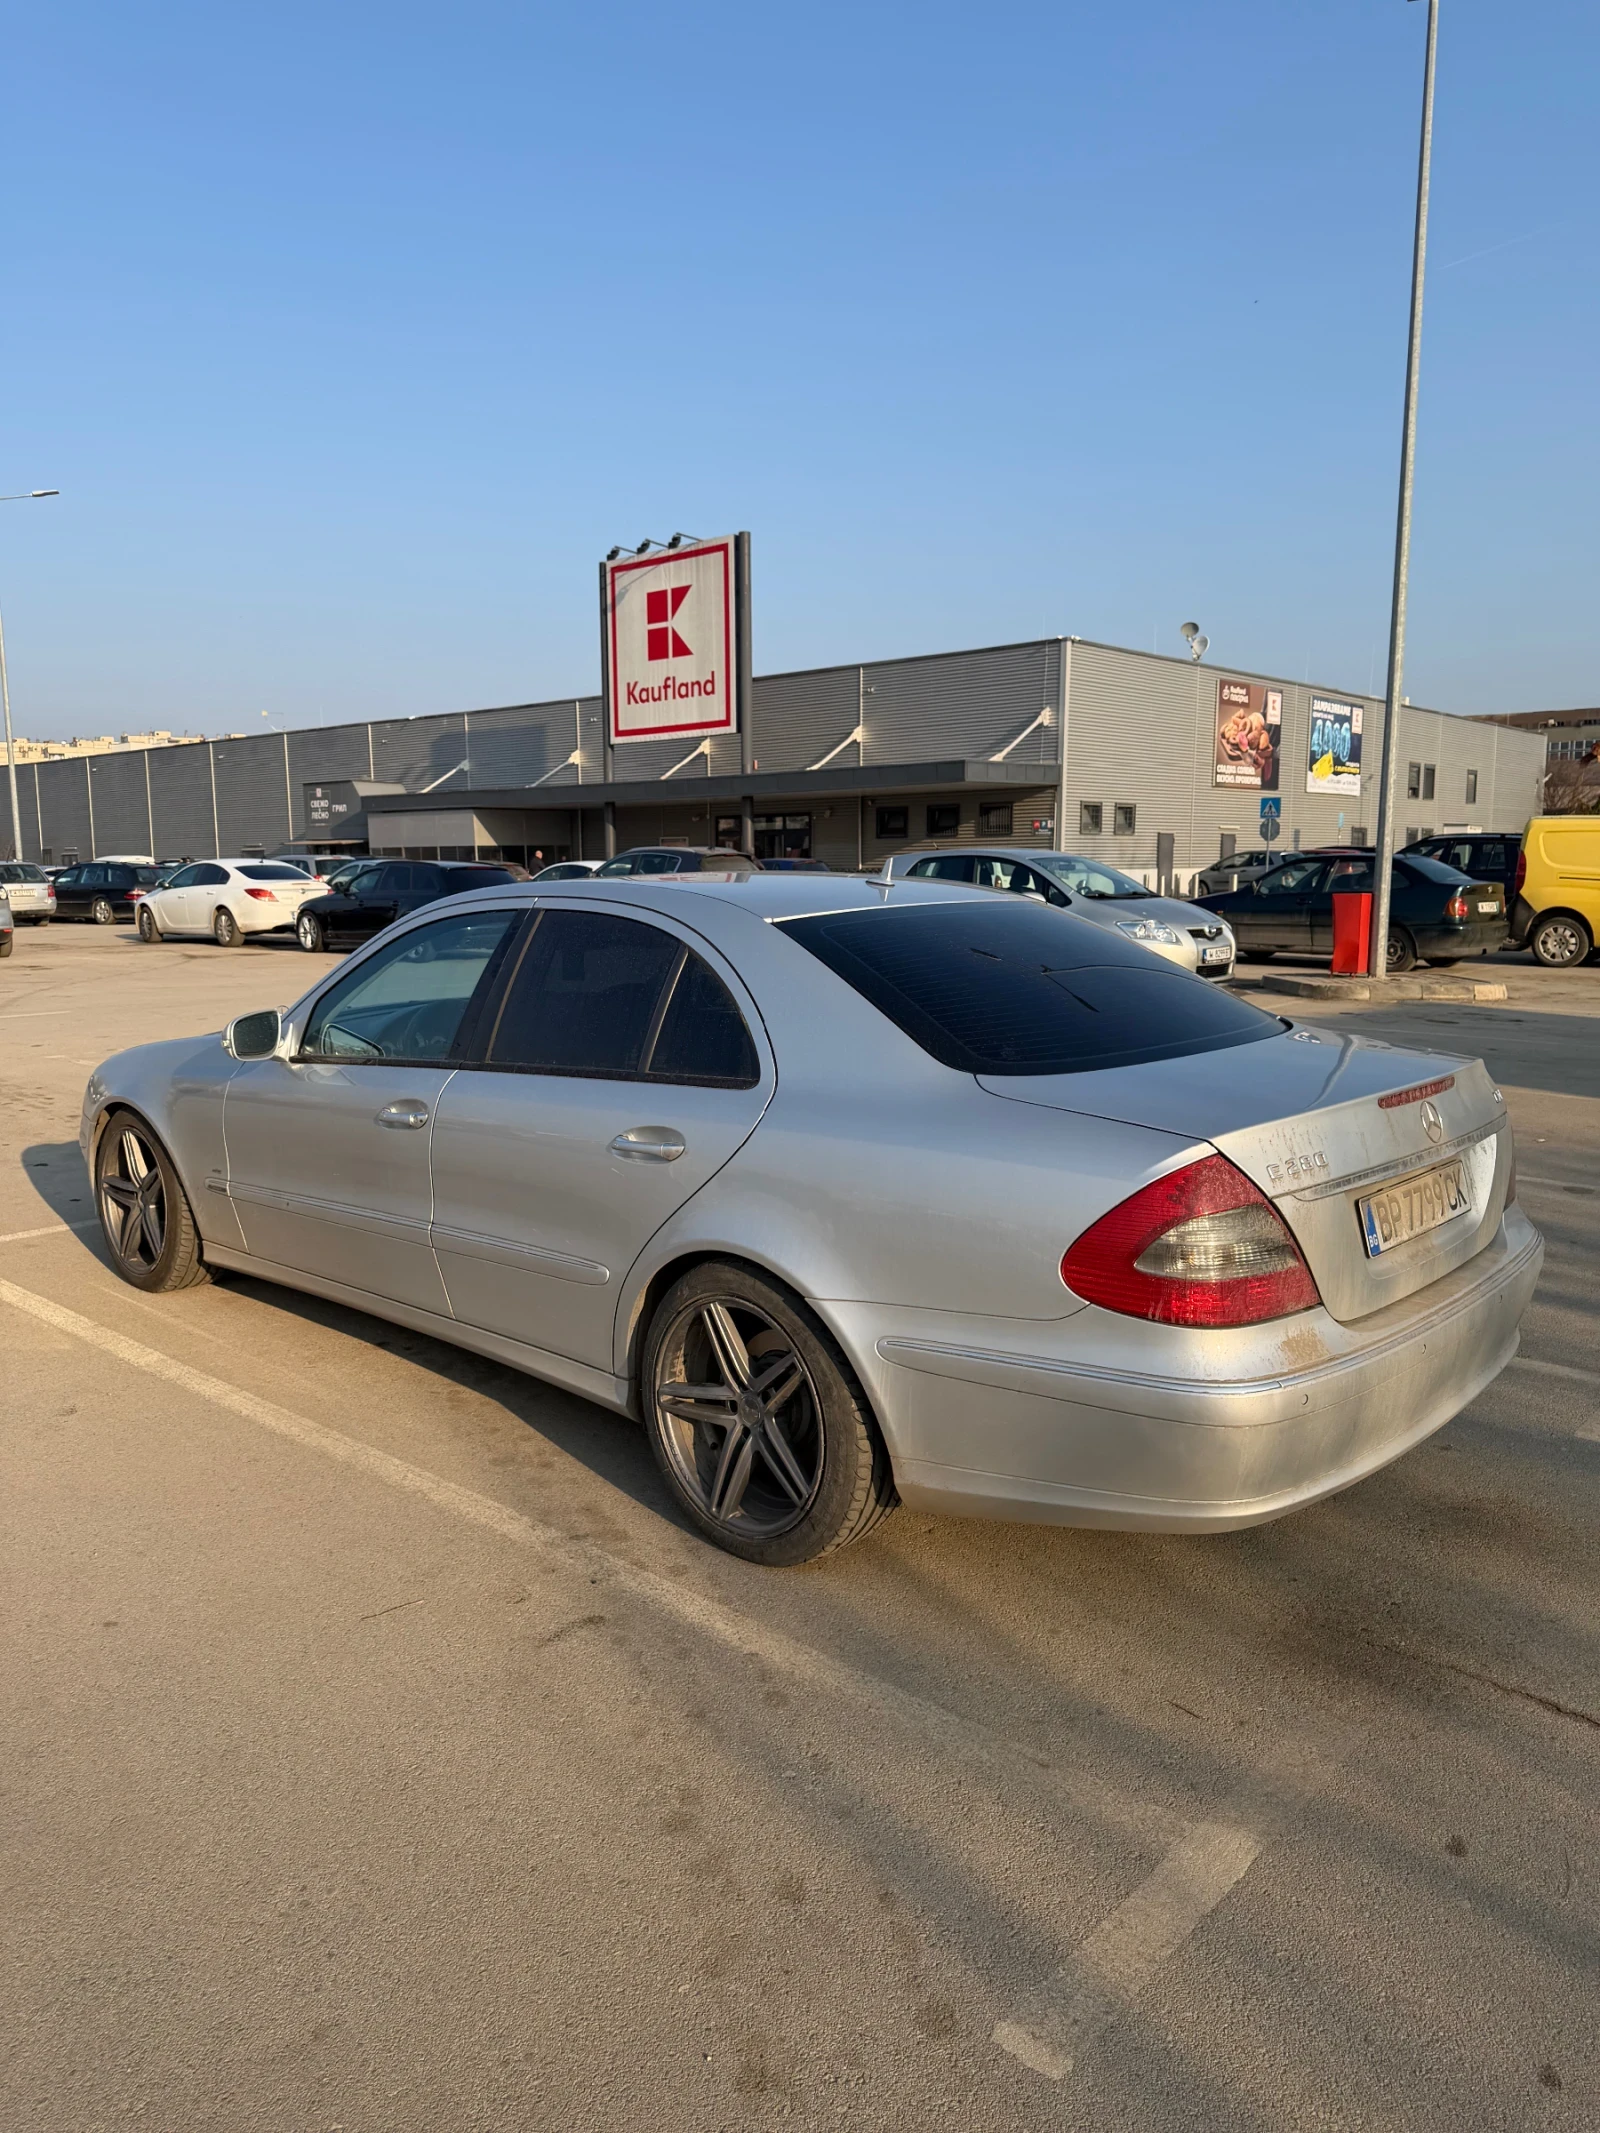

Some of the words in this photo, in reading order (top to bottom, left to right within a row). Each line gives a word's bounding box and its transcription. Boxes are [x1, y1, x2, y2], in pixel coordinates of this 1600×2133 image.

[627, 671, 715, 705] Kaufland
[1311, 719, 1351, 762] 4000
[332, 804, 347, 812] ГРИЛ
[1266, 1163, 1283, 1180] E
[1285, 1152, 1330, 1177] 280
[1374, 1195, 1401, 1244] BP
[1402, 1180, 1445, 1232] 7799
[1443, 1168, 1468, 1212] CK
[1368, 1234, 1380, 1248] BG
